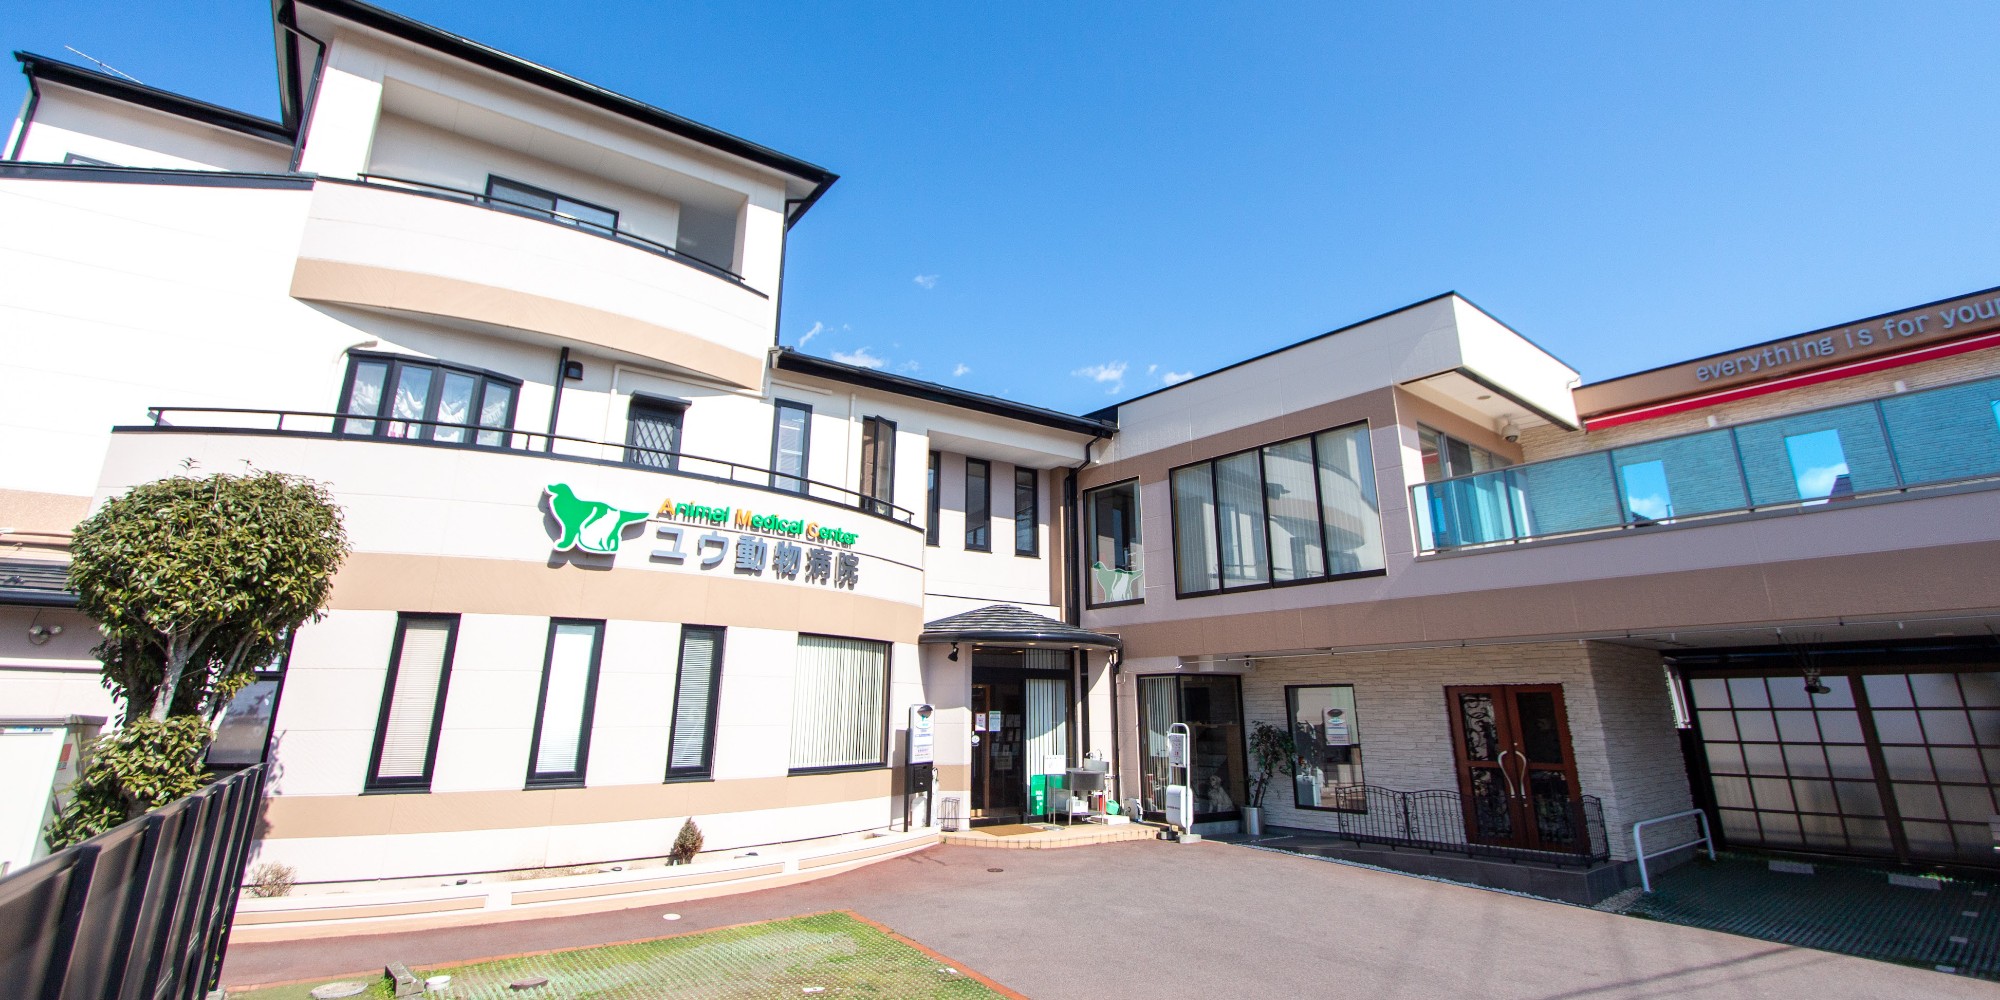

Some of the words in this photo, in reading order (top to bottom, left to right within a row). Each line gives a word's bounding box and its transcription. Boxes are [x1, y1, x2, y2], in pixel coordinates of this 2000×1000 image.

[1696, 336, 1834, 381] everything
[1845, 329, 1874, 348] is
[1883, 315, 1930, 340] for
[658, 498, 730, 523] Animal
[735, 508, 804, 535] Medical
[806, 521, 859, 545] Center
[650, 526, 859, 587] ユウ動物病院
